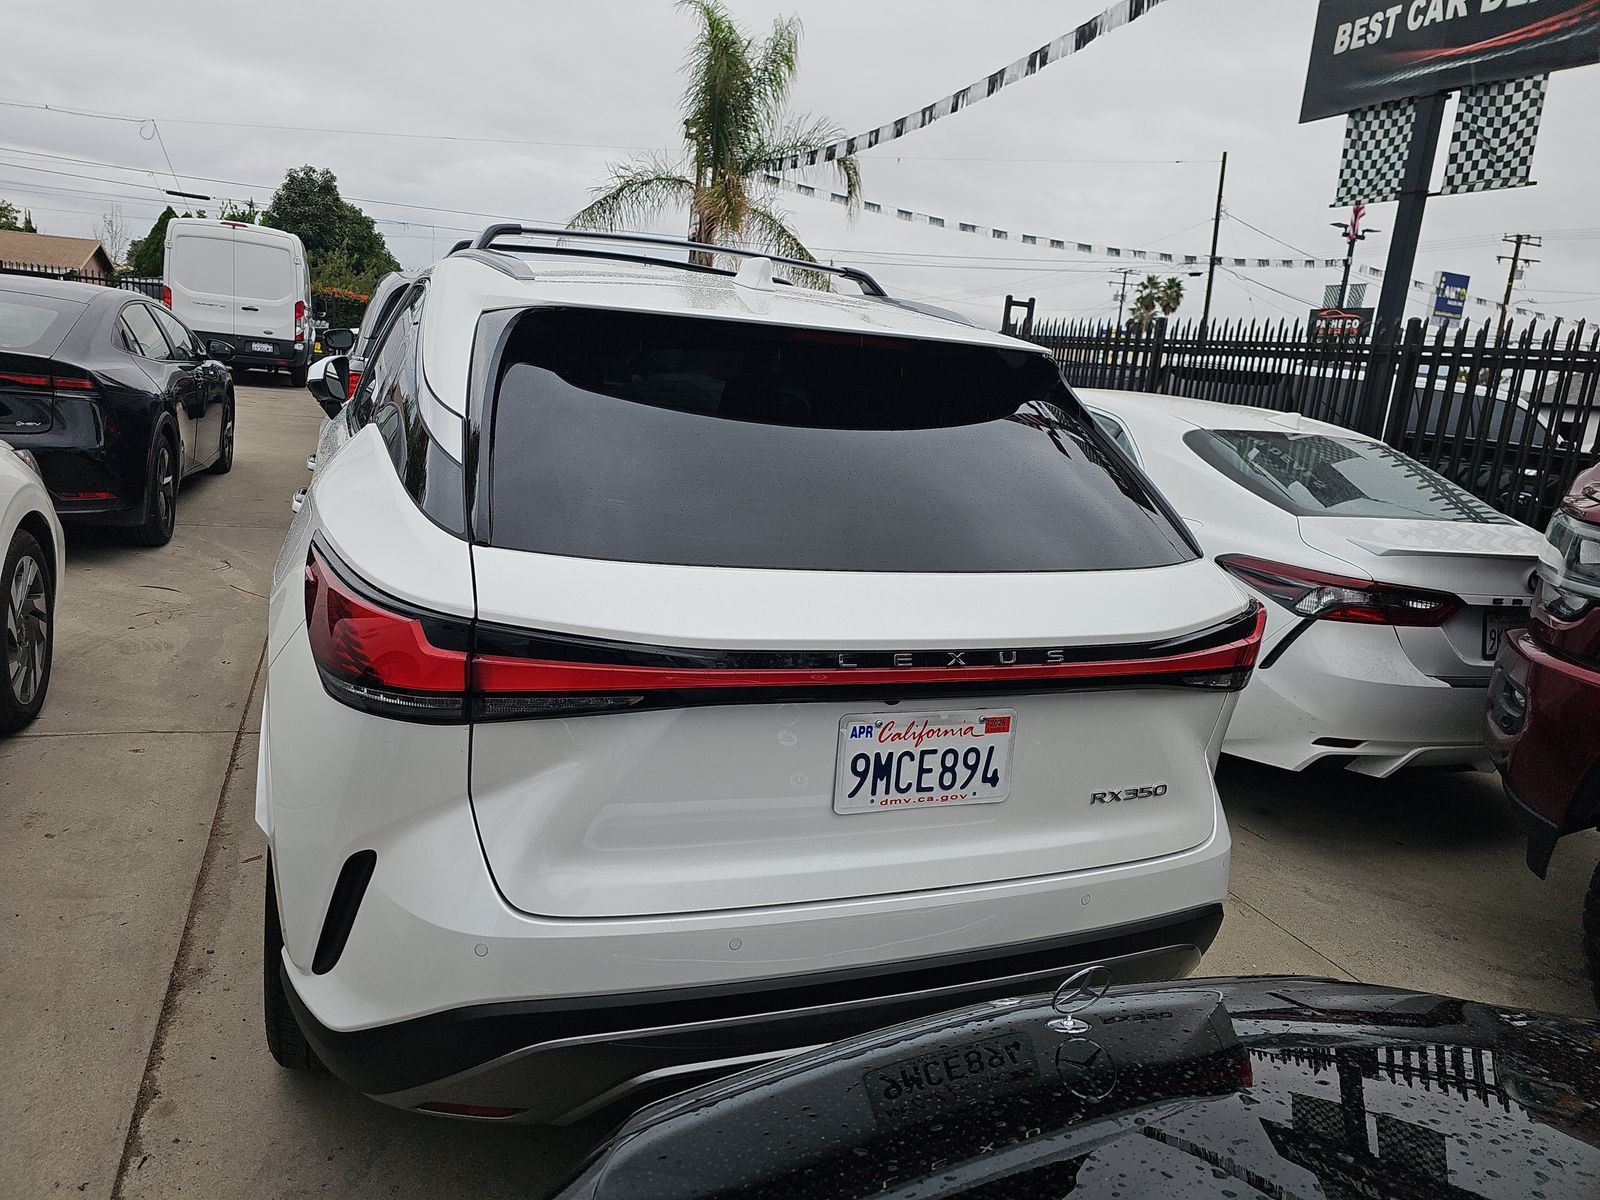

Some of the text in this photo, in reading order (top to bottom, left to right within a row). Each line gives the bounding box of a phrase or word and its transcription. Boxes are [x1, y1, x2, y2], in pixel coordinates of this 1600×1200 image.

[1333, 0, 1468, 55] BEST CAR
[838, 650, 1065, 667] LEXUS
[849, 720, 985, 748] APR California
[847, 745, 1000, 799] 9MCE894
[879, 793, 968, 806] dmv.ca.gov
